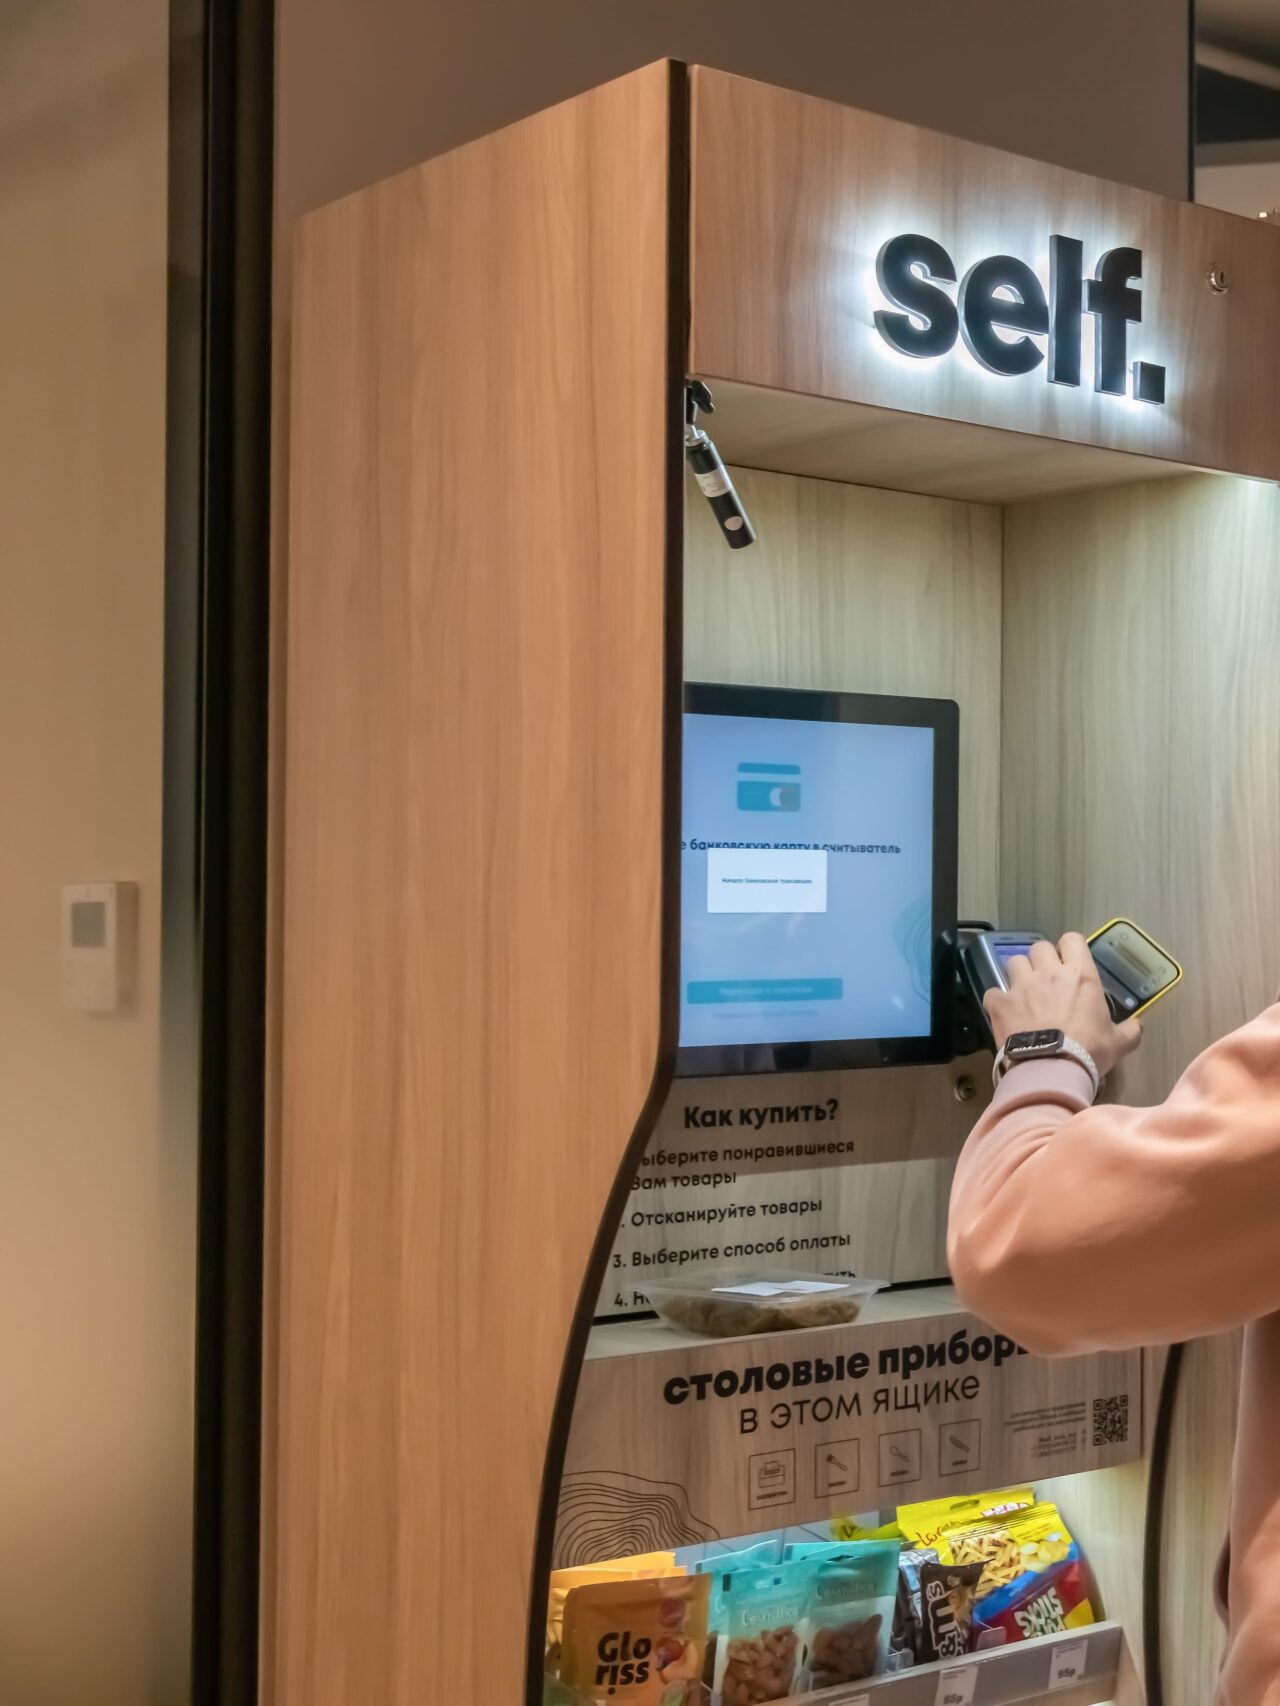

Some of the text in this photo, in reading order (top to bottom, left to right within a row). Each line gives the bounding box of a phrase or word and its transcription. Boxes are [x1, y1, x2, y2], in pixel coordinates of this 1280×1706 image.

[873, 233, 1165, 405] self.
[822, 843, 901, 854] считыватель
[684, 1099, 838, 1130] Как купить?
[642, 1141, 855, 1167] ыберите понравившиеся
[672, 1171, 737, 1188] товары
[631, 1203, 756, 1227] Отсканируйте
[761, 1200, 823, 1217] товары
[613, 1234, 851, 1268] 3. Выберите способ оплаты
[614, 1293, 628, 1307] 4.
[663, 1352, 870, 1404] столовые
[770, 1393, 862, 1430] этом
[873, 1375, 980, 1413] ящике
[597, 1631, 652, 1663] Glo
